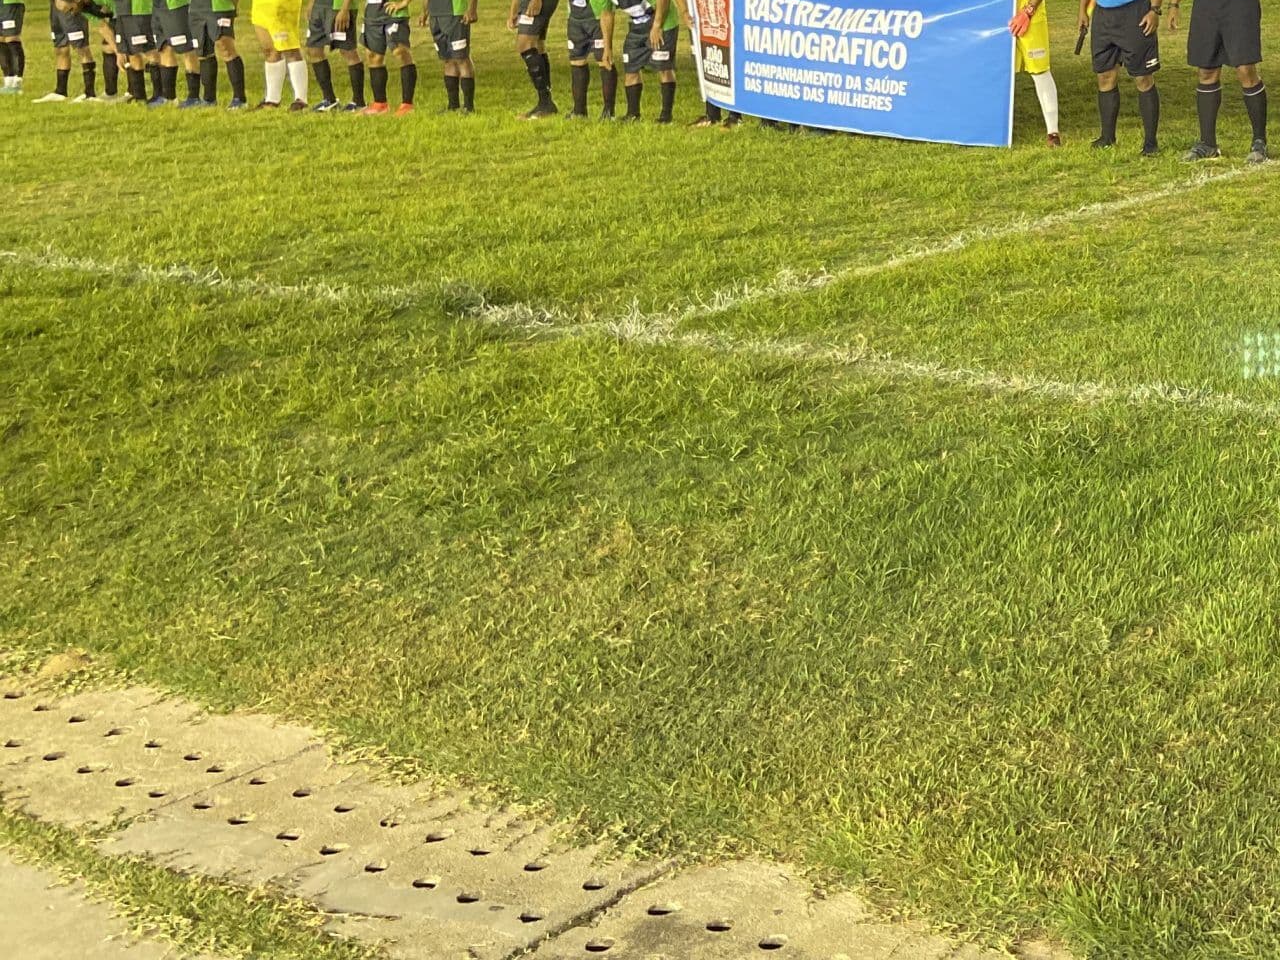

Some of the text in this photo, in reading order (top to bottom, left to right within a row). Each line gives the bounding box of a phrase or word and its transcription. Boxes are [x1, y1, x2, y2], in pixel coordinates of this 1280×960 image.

[744, 25, 908, 70] MAMOGRÁFICO
[703, 59, 729, 79] PESSOA
[744, 61, 842, 87] ACOMPANHAMENTO
[845, 74, 862, 90] DA
[865, 75, 908, 96] SAÚDE
[744, 76, 762, 93] DAS
[763, 79, 801, 100] MAMAS
[803, 87, 825, 103] DAS
[827, 91, 893, 112] MULHERES
